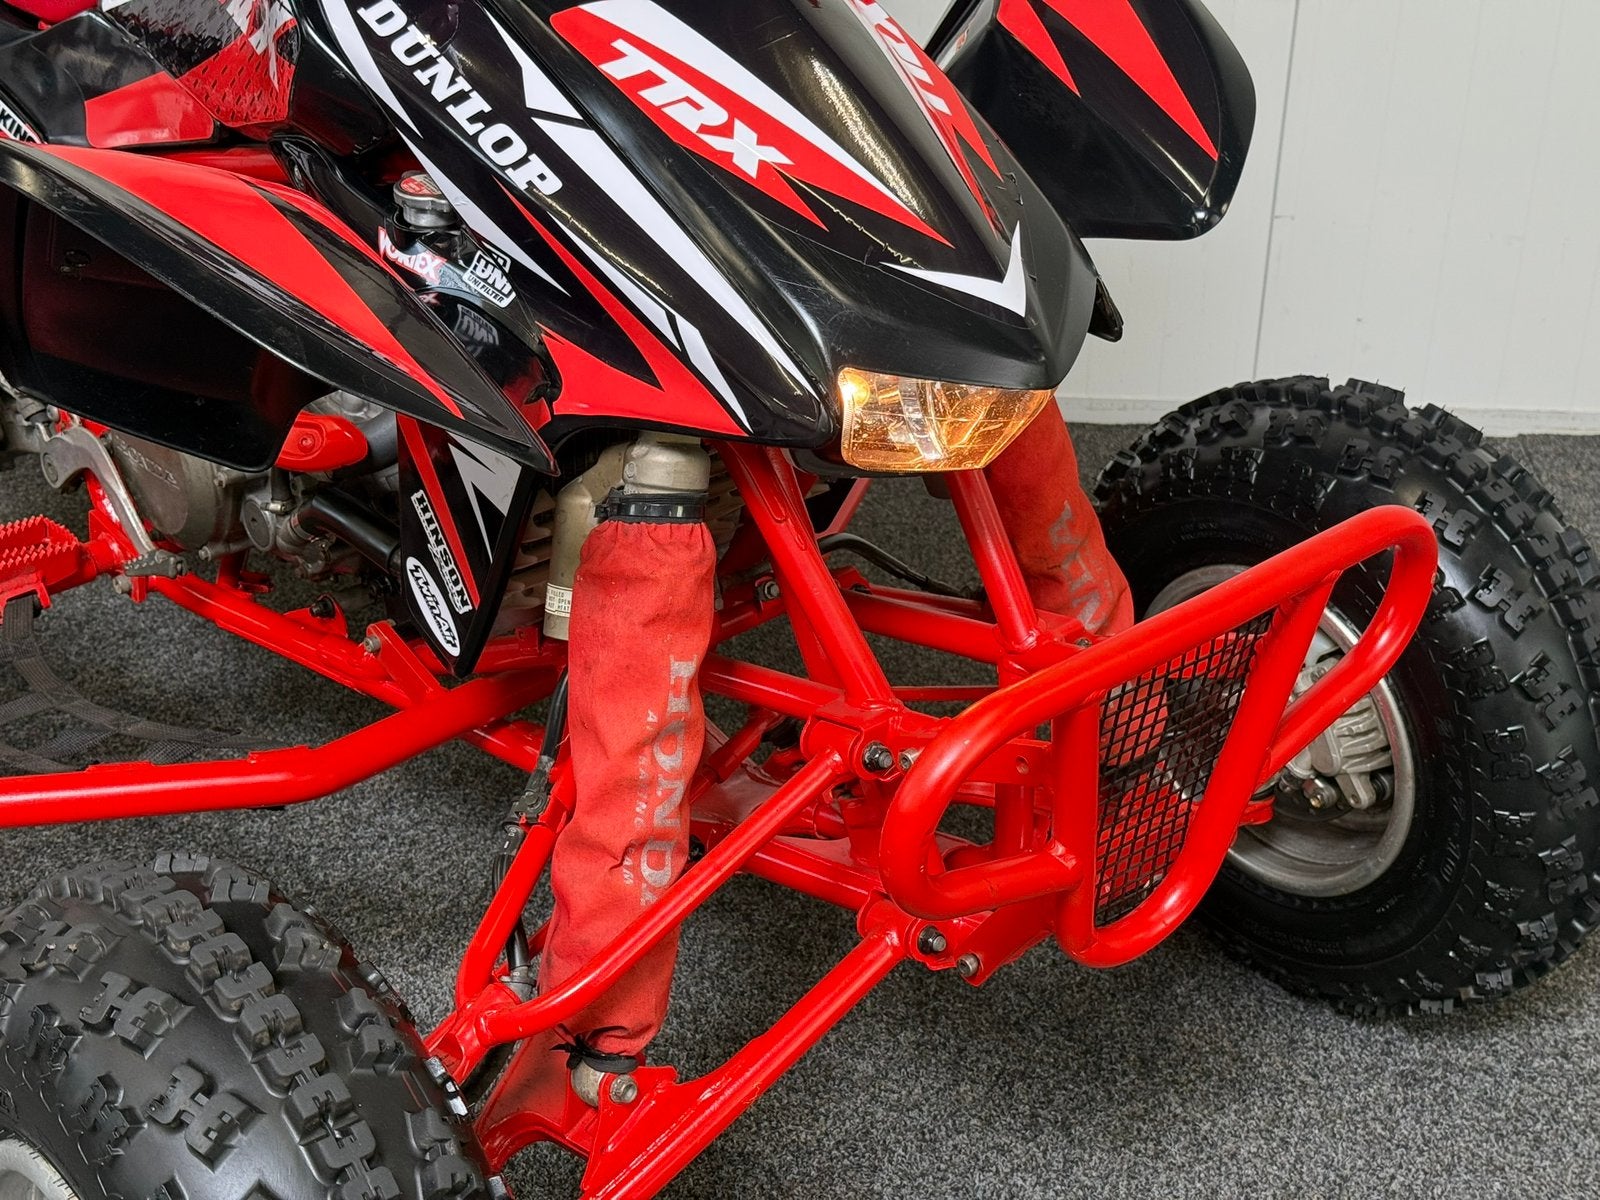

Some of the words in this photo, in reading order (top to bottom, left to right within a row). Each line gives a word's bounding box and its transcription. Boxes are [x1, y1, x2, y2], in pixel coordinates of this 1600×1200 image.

[357, 0, 563, 196] DUNLOP
[598, 38, 795, 179] TRX
[466, 273, 482, 287] UNI
[479, 282, 505, 304] FILTER
[415, 493, 470, 608] HINSON
[1049, 500, 1107, 632] NDA
